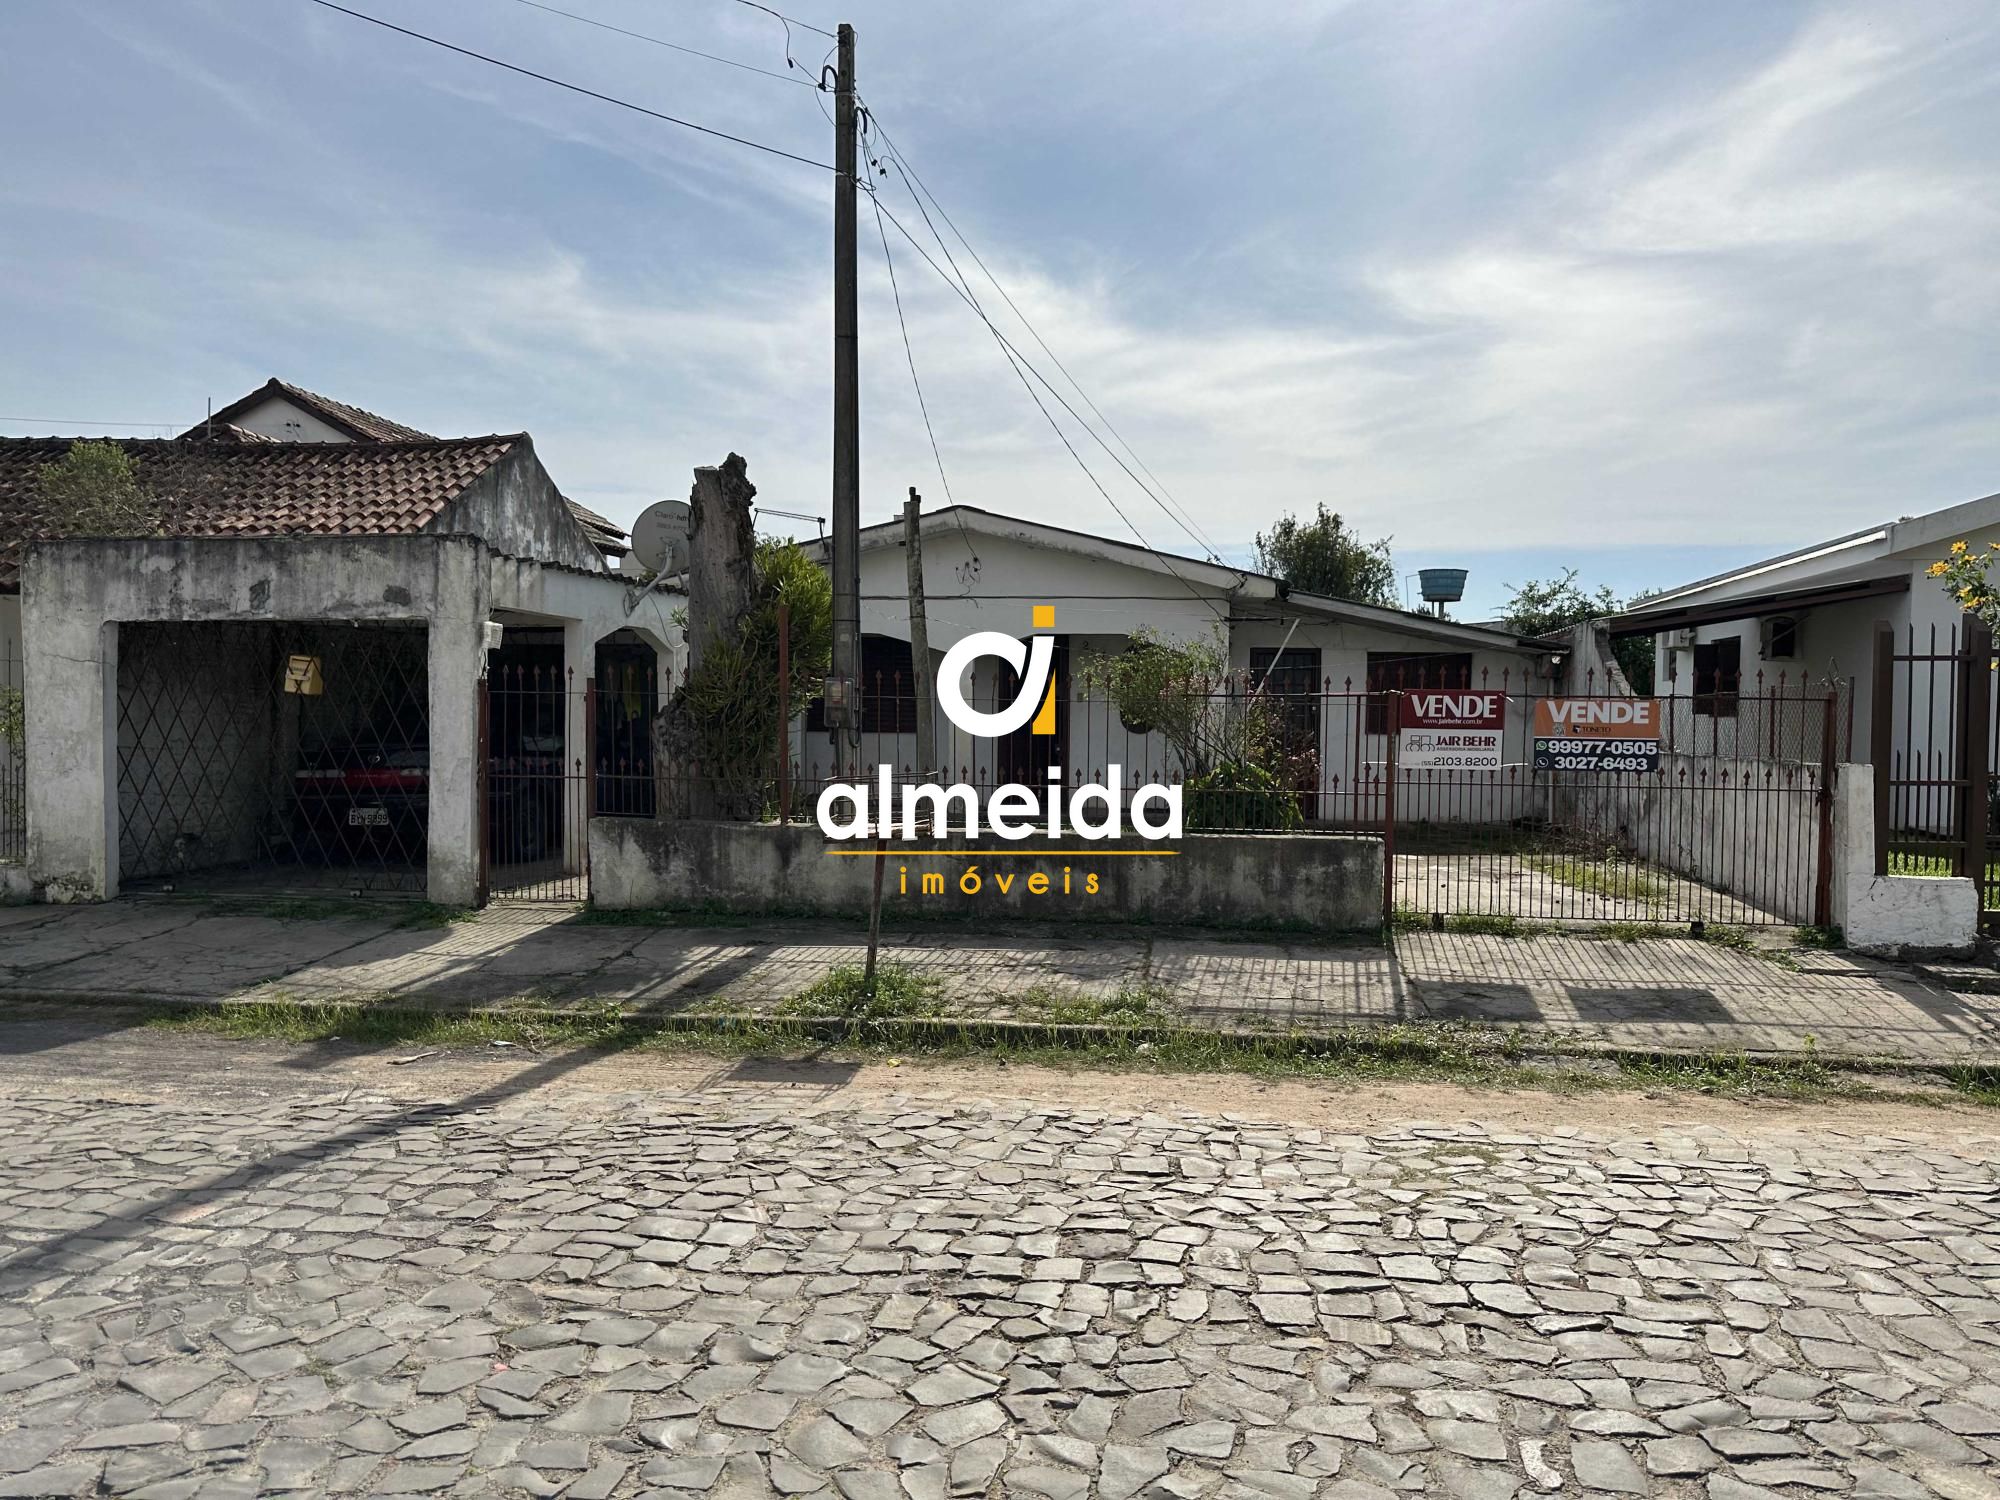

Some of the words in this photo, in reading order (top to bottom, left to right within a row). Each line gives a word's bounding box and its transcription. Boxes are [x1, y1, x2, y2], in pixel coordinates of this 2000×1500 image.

[1411, 694, 1498, 718] VENDE
[1546, 700, 1650, 724] VENDE
[1435, 735, 1461, 746] JAIR
[1462, 736, 1497, 747] BEHR
[1548, 740, 1658, 755] 99977-0505
[1433, 757, 1498, 767] 2103.8200
[1554, 756, 1648, 770] 3027-6493
